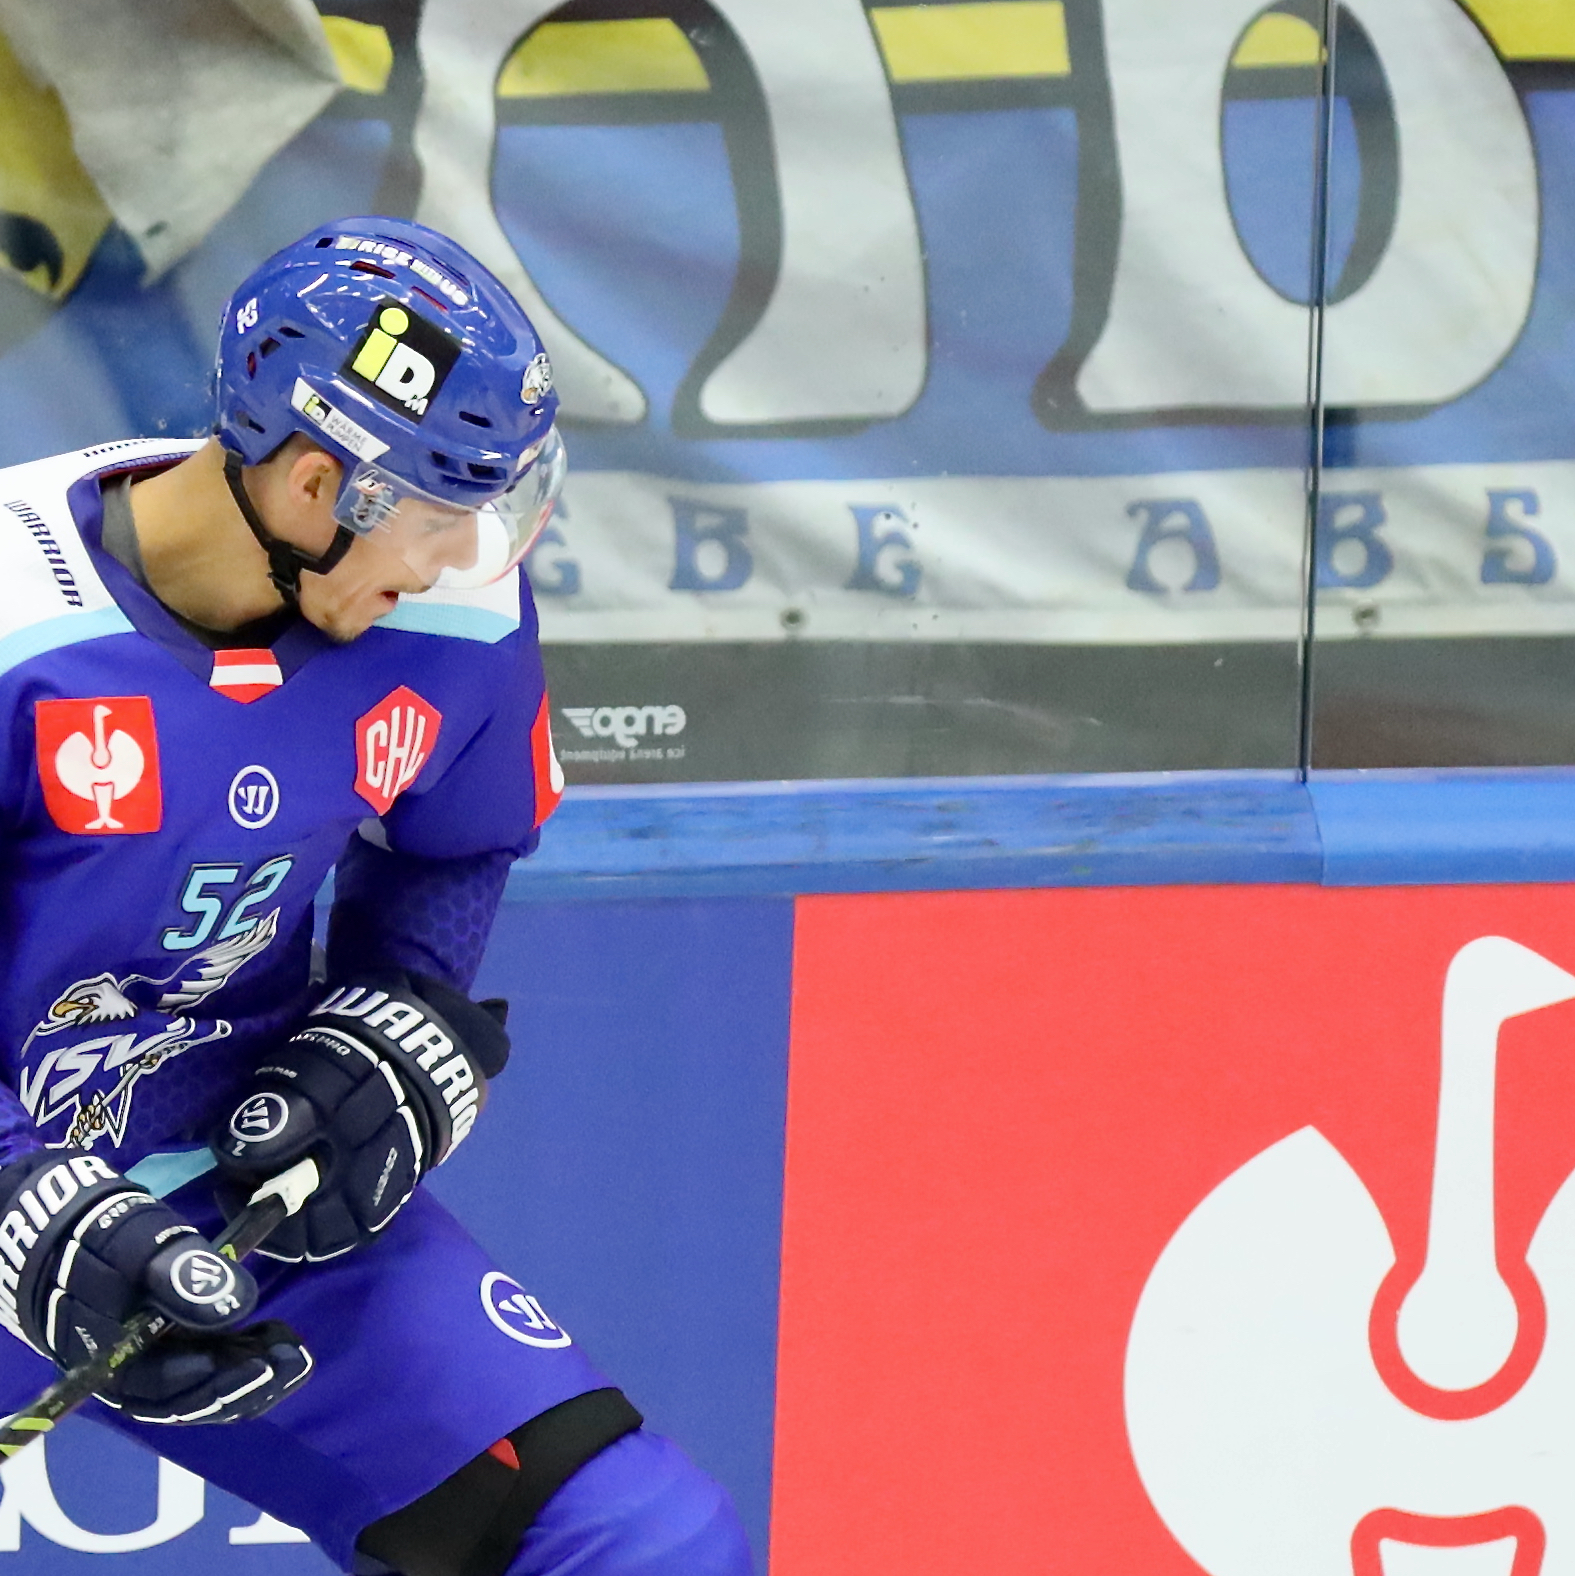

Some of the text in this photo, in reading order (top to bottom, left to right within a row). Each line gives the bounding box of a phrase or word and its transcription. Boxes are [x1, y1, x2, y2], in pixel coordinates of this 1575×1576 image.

[3, 499, 83, 607] WARRIOR
[365, 705, 426, 800] CHL
[162, 854, 295, 951] 52
